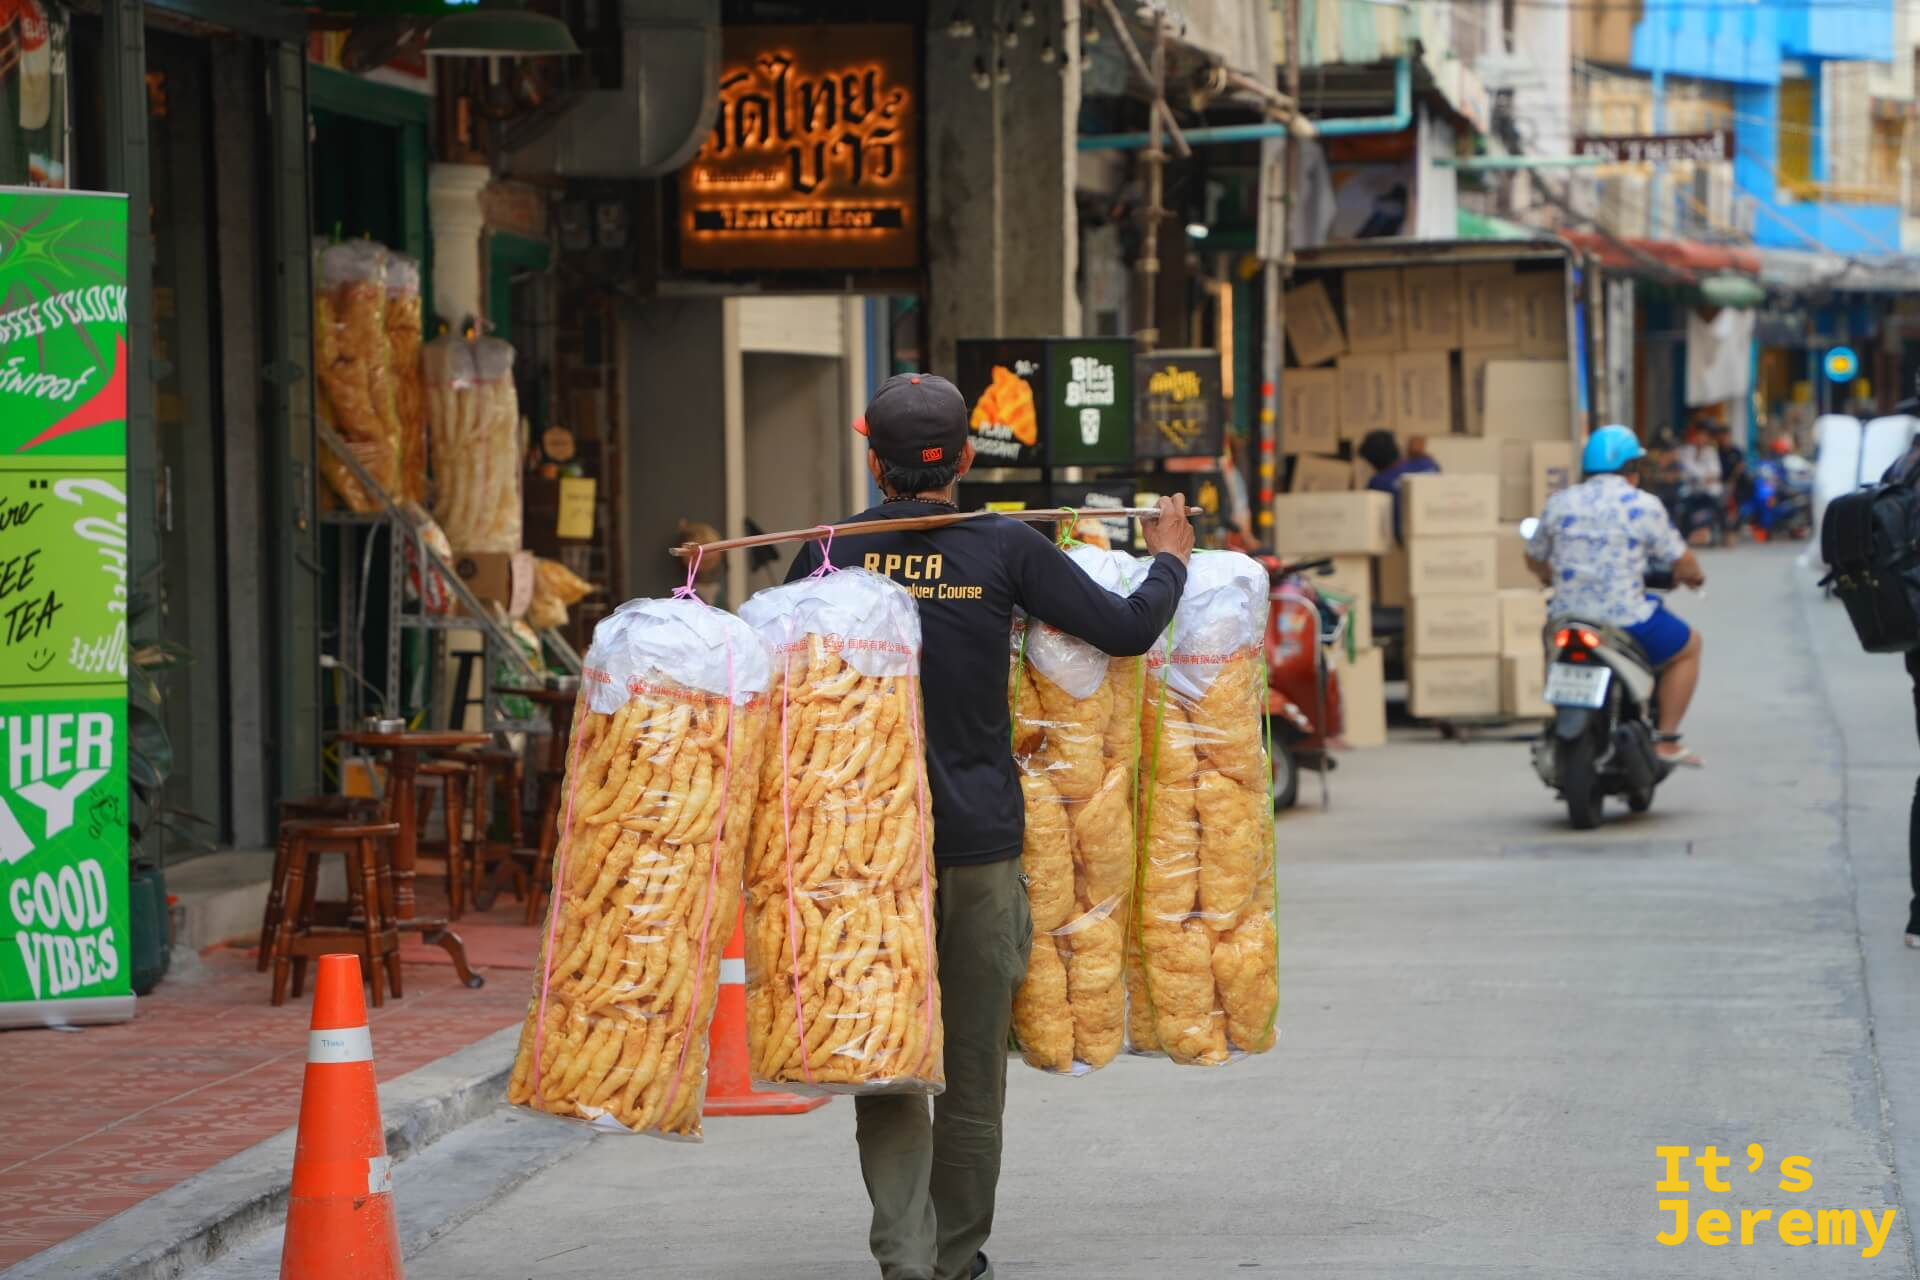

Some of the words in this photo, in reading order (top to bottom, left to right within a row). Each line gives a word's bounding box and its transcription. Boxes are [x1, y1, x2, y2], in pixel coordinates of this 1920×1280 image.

[4, 589, 63, 646] TEA
[938, 583, 982, 599] Course
[10, 858, 108, 932] GOOD
[16, 926, 118, 1000] VIBES
